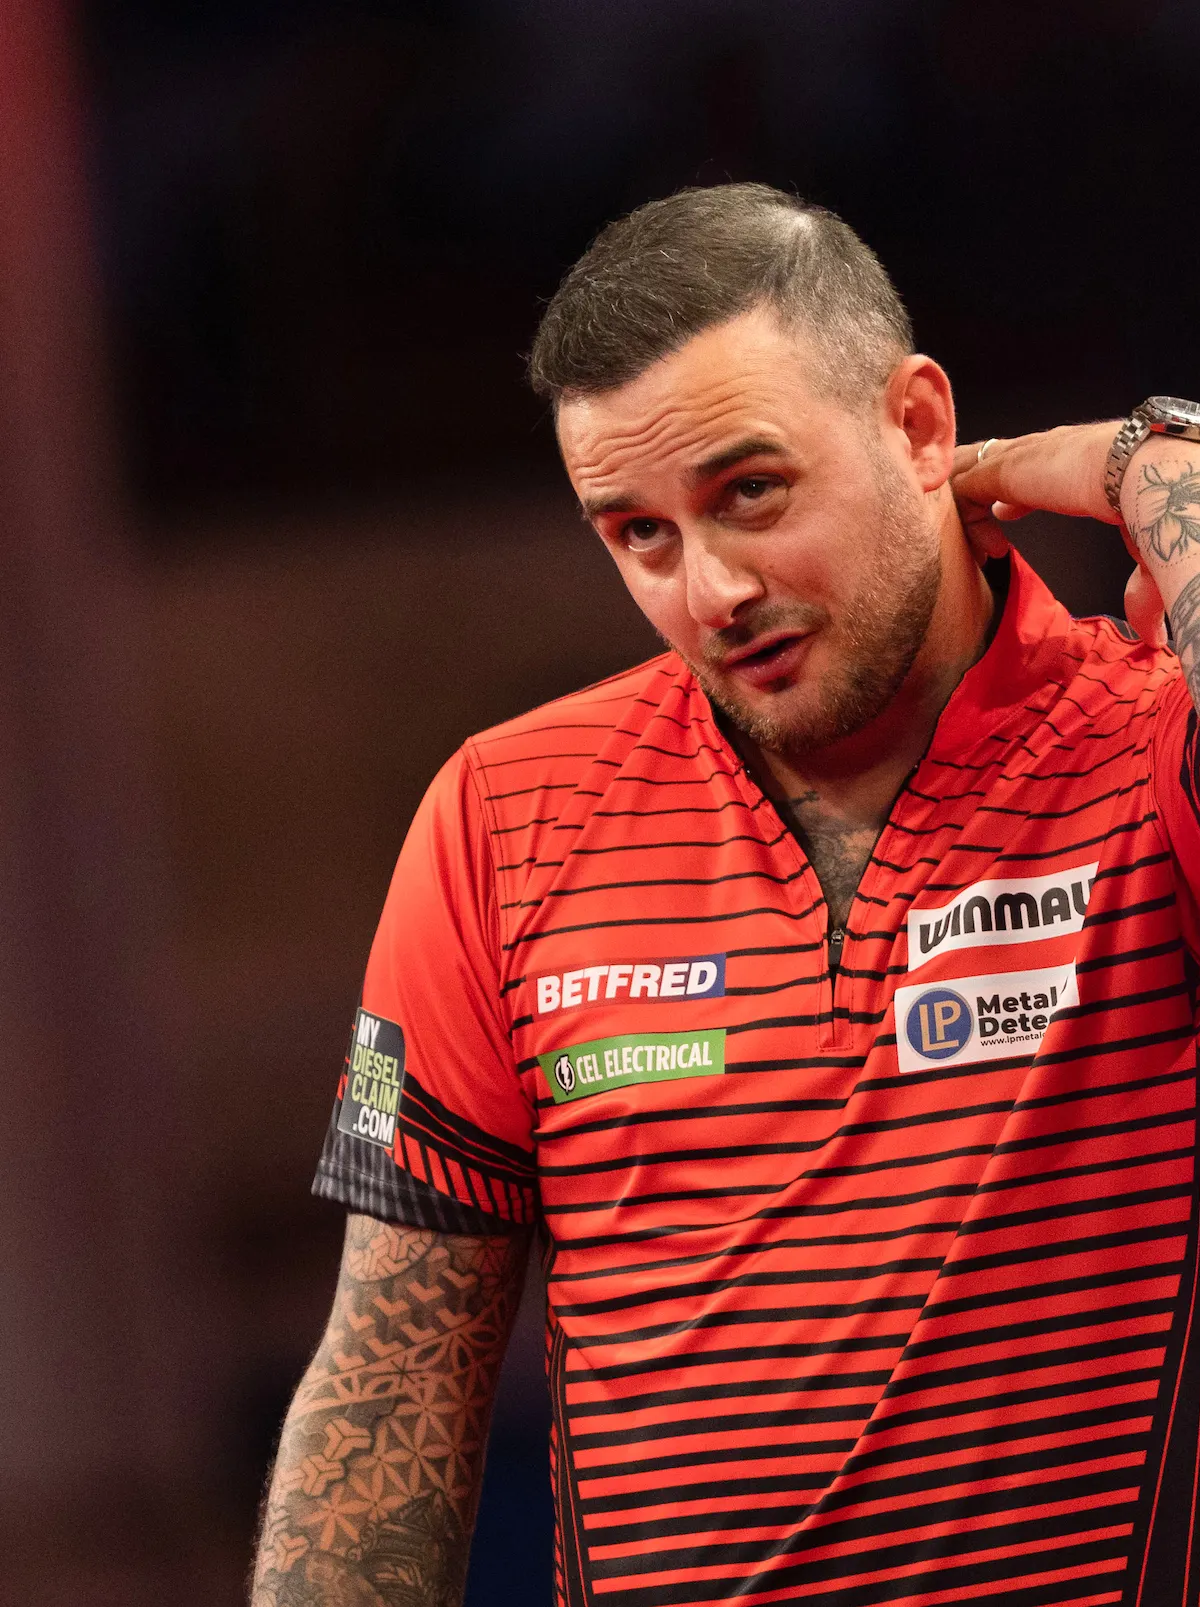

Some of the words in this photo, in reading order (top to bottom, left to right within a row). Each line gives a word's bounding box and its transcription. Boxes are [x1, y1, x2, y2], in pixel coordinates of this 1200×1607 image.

[919, 877, 1096, 954] WINMAU
[537, 961, 718, 1014] BETFRED
[976, 986, 1058, 1016] Metal
[357, 1013, 380, 1049] MY
[919, 1000, 962, 1052] LP
[978, 1013, 1048, 1038] Dete
[352, 1043, 400, 1087] DIESEL
[576, 1055, 603, 1084] CEL
[603, 1041, 713, 1078] ELECTRICAL
[351, 1073, 399, 1115] CLAIM
[352, 1105, 395, 1144] .COM
